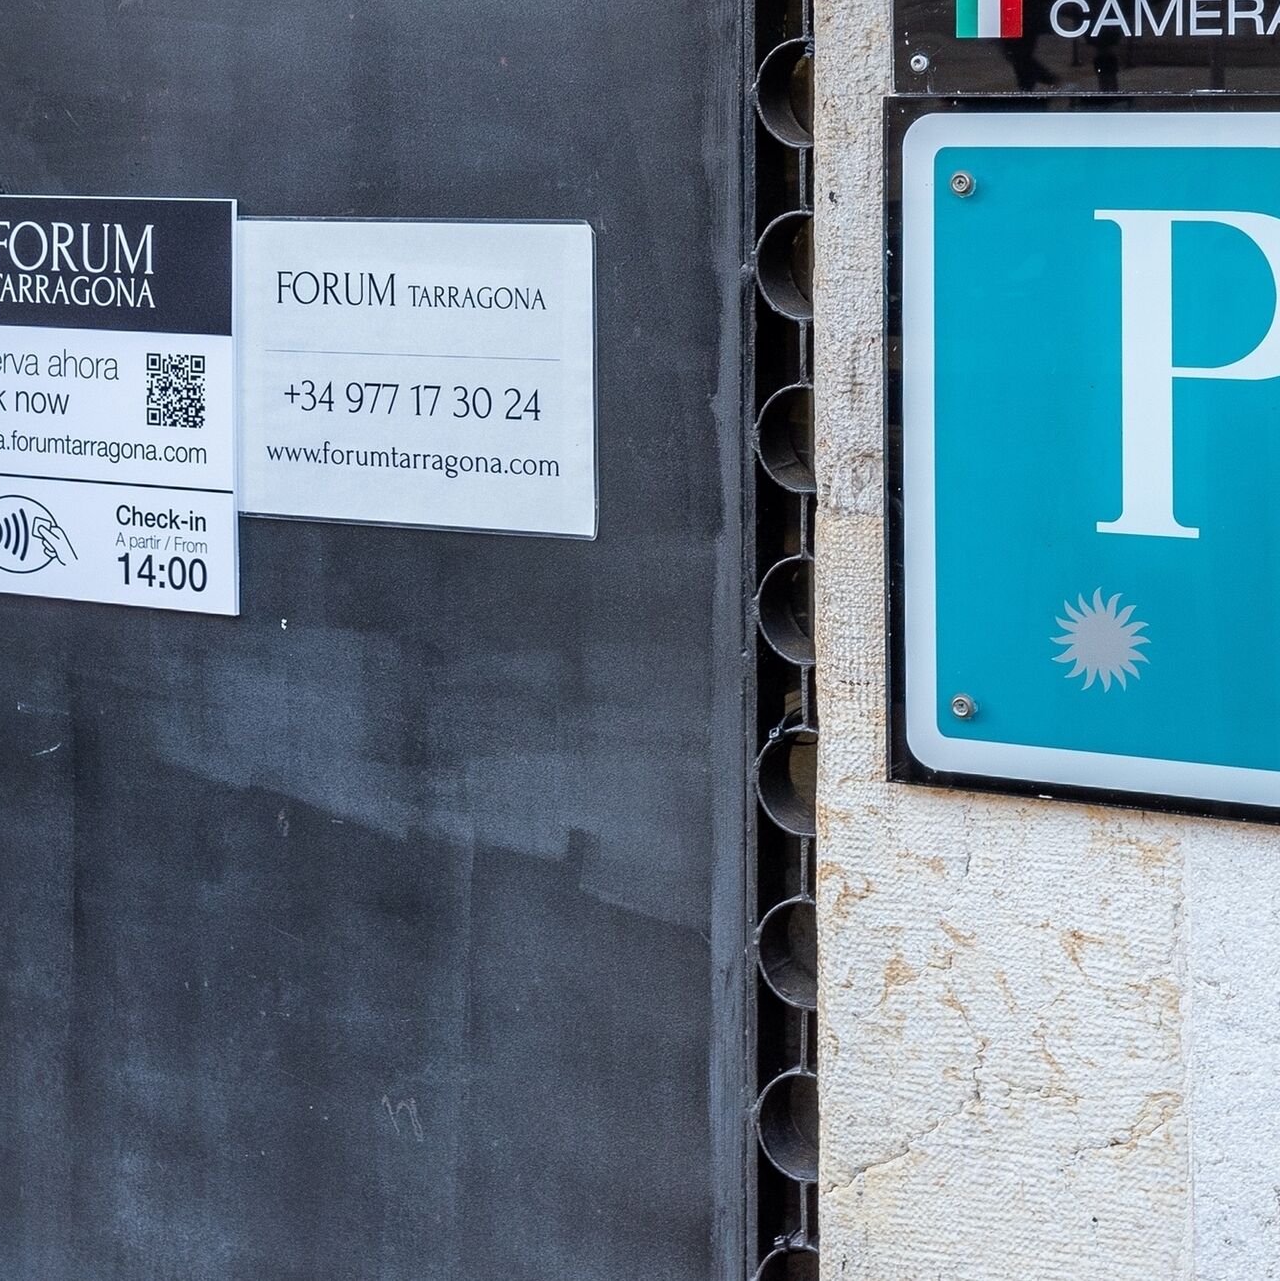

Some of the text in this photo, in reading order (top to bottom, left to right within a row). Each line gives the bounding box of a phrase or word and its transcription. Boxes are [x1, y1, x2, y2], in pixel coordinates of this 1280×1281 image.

[278, 272, 546, 309] FORUM TARRAGONA
[48, 349, 119, 380] ahora
[16, 391, 69, 414] now
[284, 380, 540, 420] +34 977 17 30 24
[267, 441, 559, 478] www.forumtarragona.com
[116, 505, 206, 532] Check-in
[116, 532, 207, 553] A partir / From
[118, 554, 208, 593] 14:00
